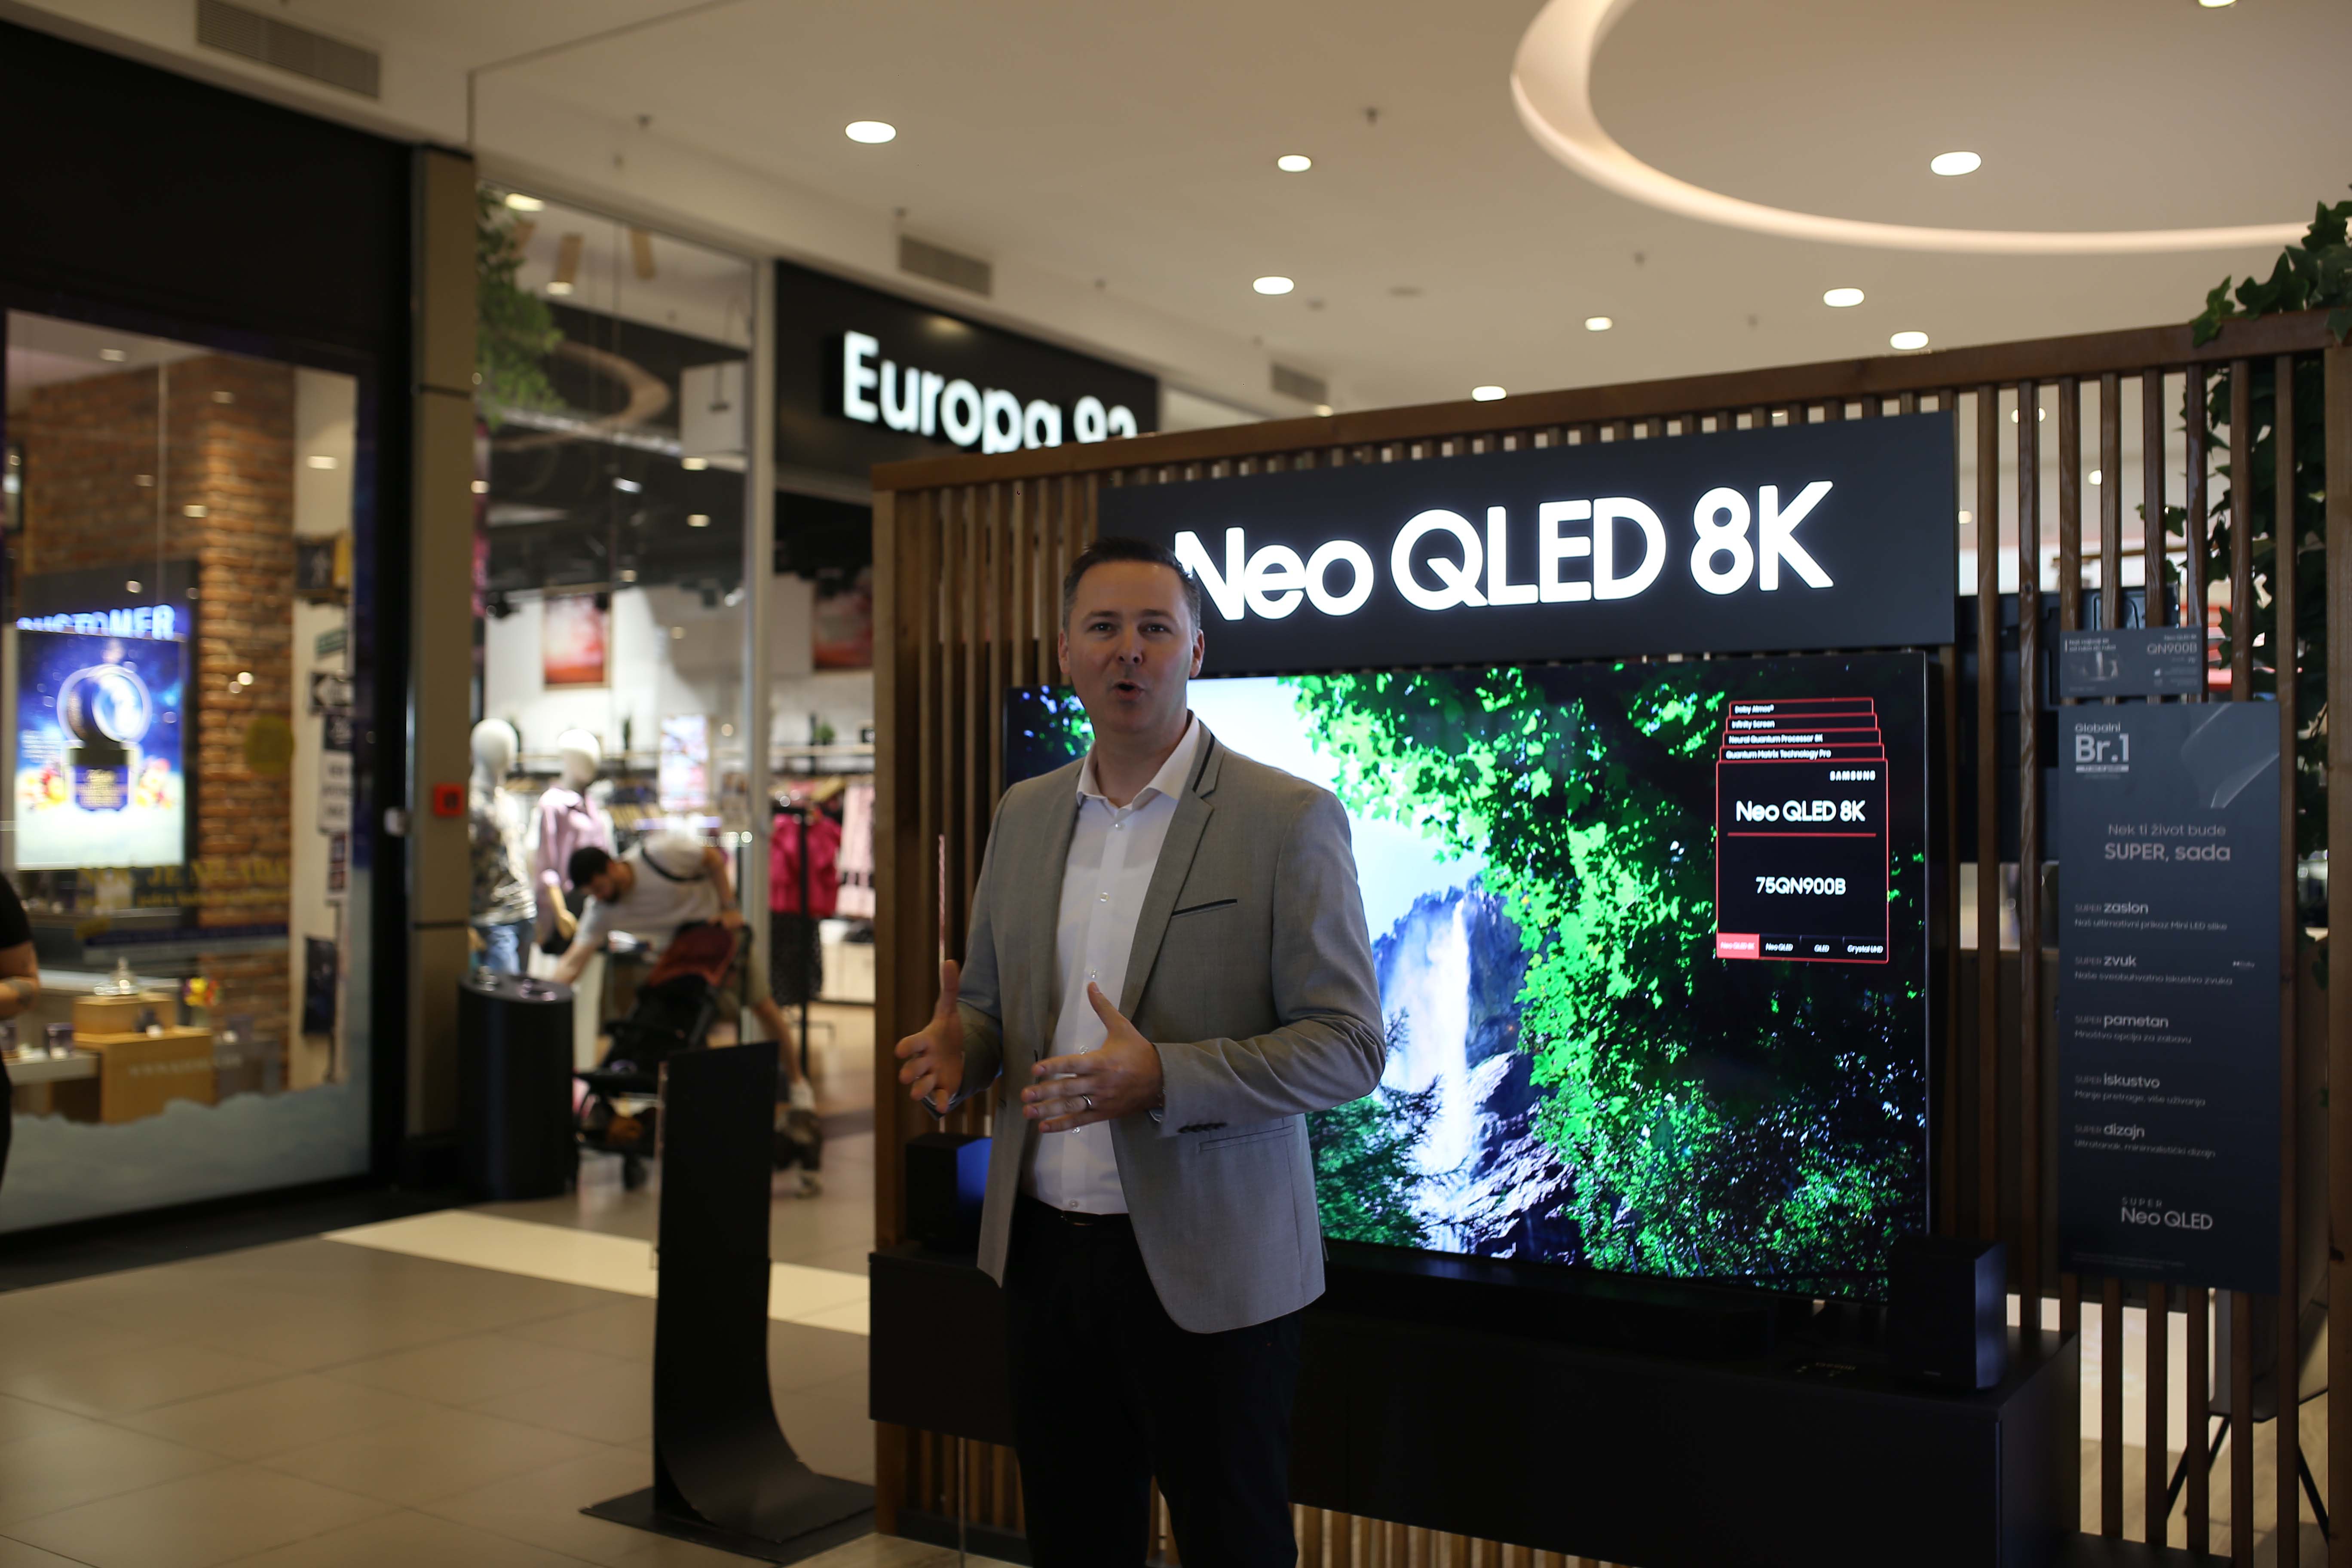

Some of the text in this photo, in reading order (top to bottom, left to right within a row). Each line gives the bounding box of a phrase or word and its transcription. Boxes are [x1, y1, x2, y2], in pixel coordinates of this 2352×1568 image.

[844, 331, 1062, 455] Europa
[1174, 480, 1834, 621] Neo QLED 8K
[2146, 642, 2197, 655] QN900B
[2075, 721, 2121, 733] Globalni
[1781, 734, 1813, 743] Processor
[1779, 749, 1819, 760] Technology
[1819, 748, 1831, 758] Pro
[2076, 733, 2129, 763] Br.1
[1829, 770, 1876, 781] SAMSUNG
[1736, 799, 1866, 822] Neo QLED 8K
[2108, 824, 2226, 836] Nek ti život bude
[2104, 843, 2230, 862] SUPER, sada
[1755, 876, 1846, 895] 75QN900B
[2075, 902, 2149, 914] SUPER zaslon
[2140, 920, 2168, 931] prikaz
[2190, 921, 2205, 930] LED
[2075, 955, 2137, 967] SUPER zvuk
[2104, 1014, 2169, 1029] pametan
[2104, 1073, 2160, 1089] iskustvo
[2104, 1123, 2145, 1141] dizajn
[2121, 1195, 2163, 1208] SUPER
[2121, 1207, 2214, 1230] Neo QLED
